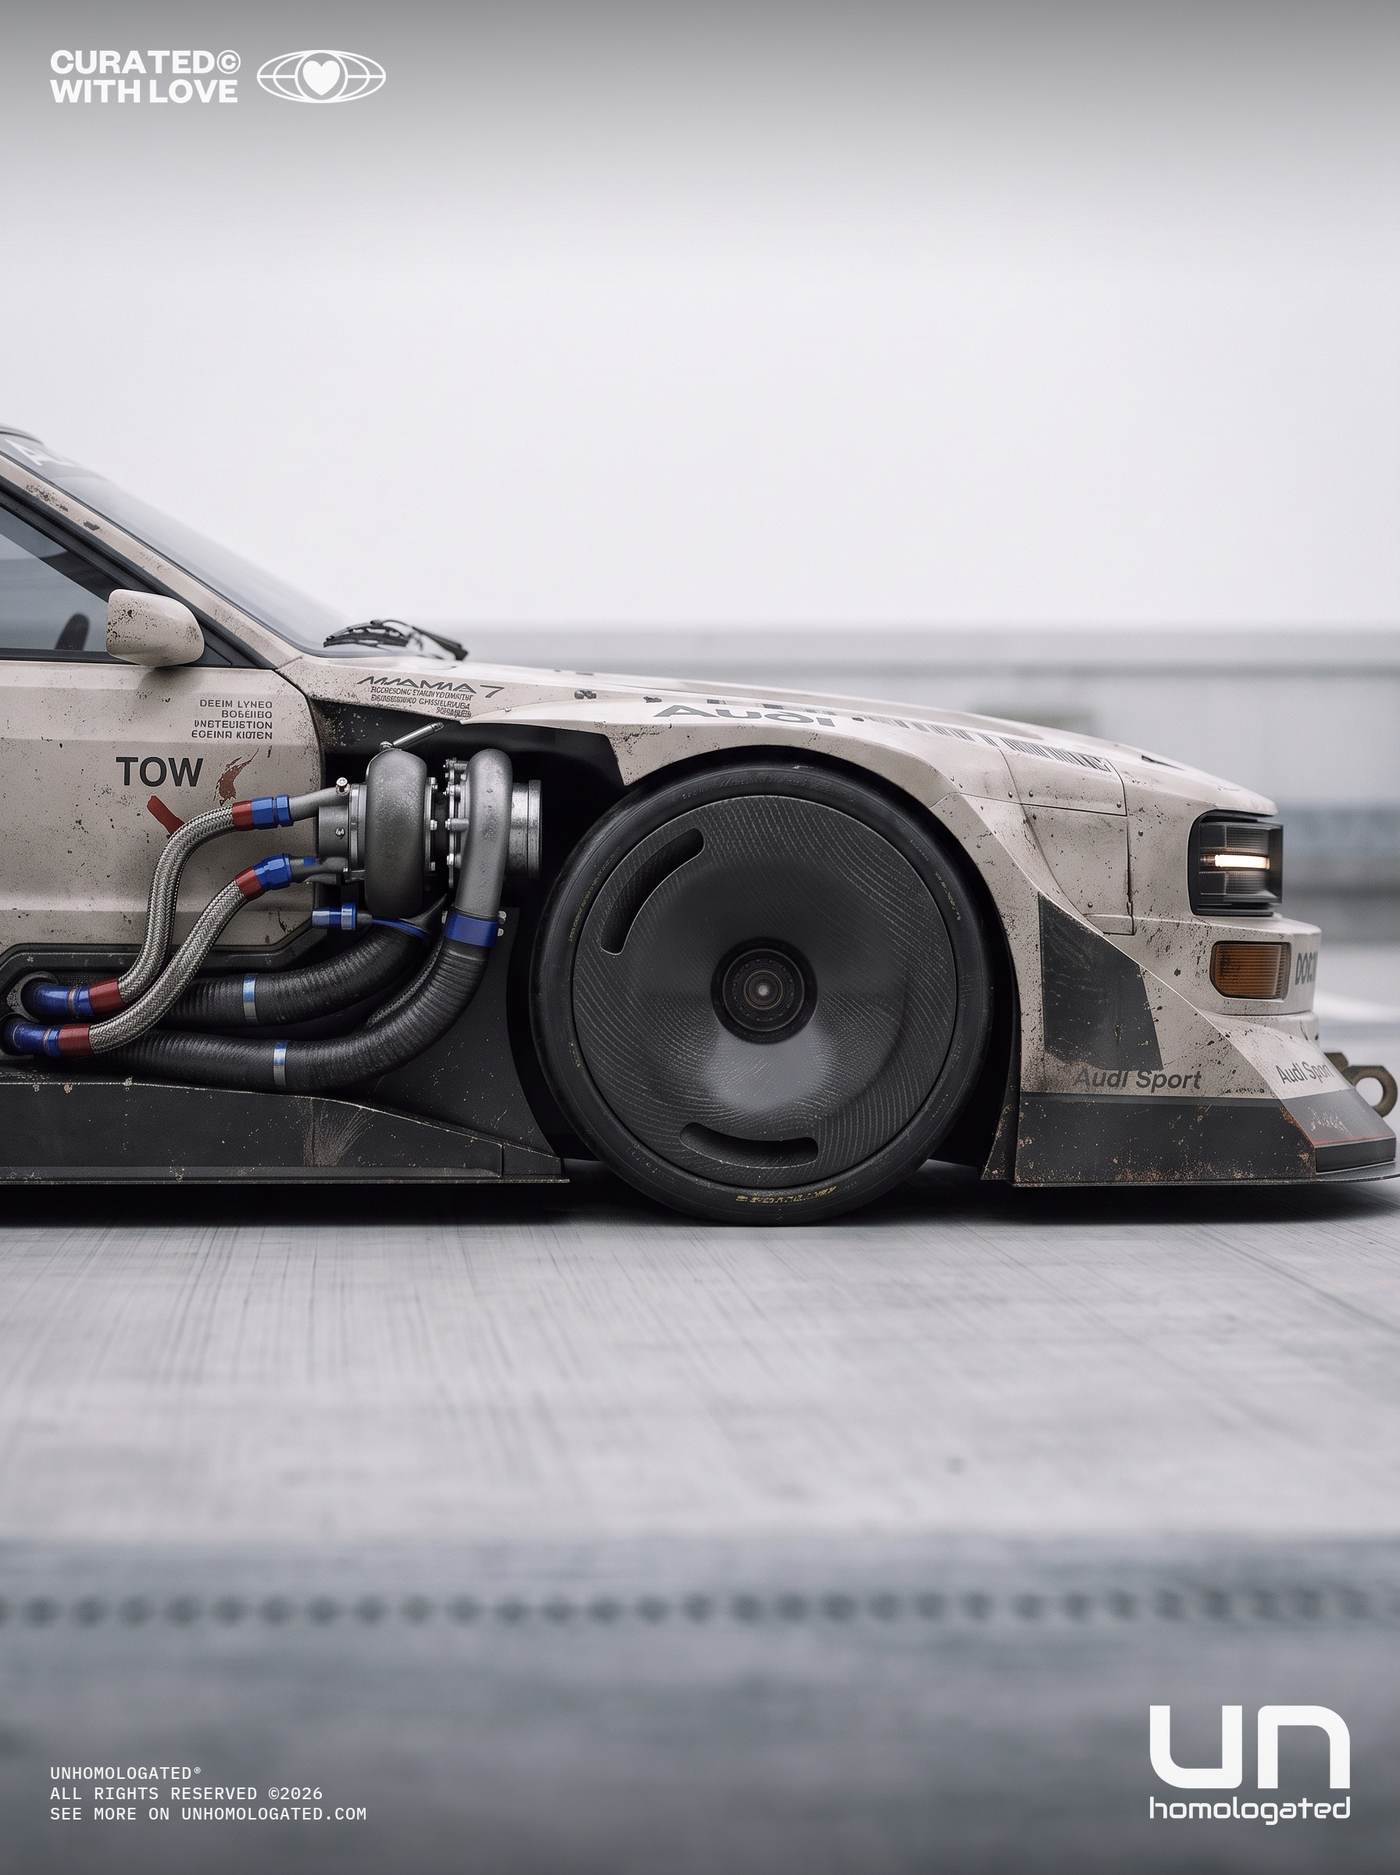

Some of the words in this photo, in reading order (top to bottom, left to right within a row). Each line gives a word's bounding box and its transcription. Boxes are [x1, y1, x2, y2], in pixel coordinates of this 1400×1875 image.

[115, 756, 204, 788] TOW
[1072, 1066, 1129, 1089] Audi
[1136, 1068, 1202, 1093] Sport
